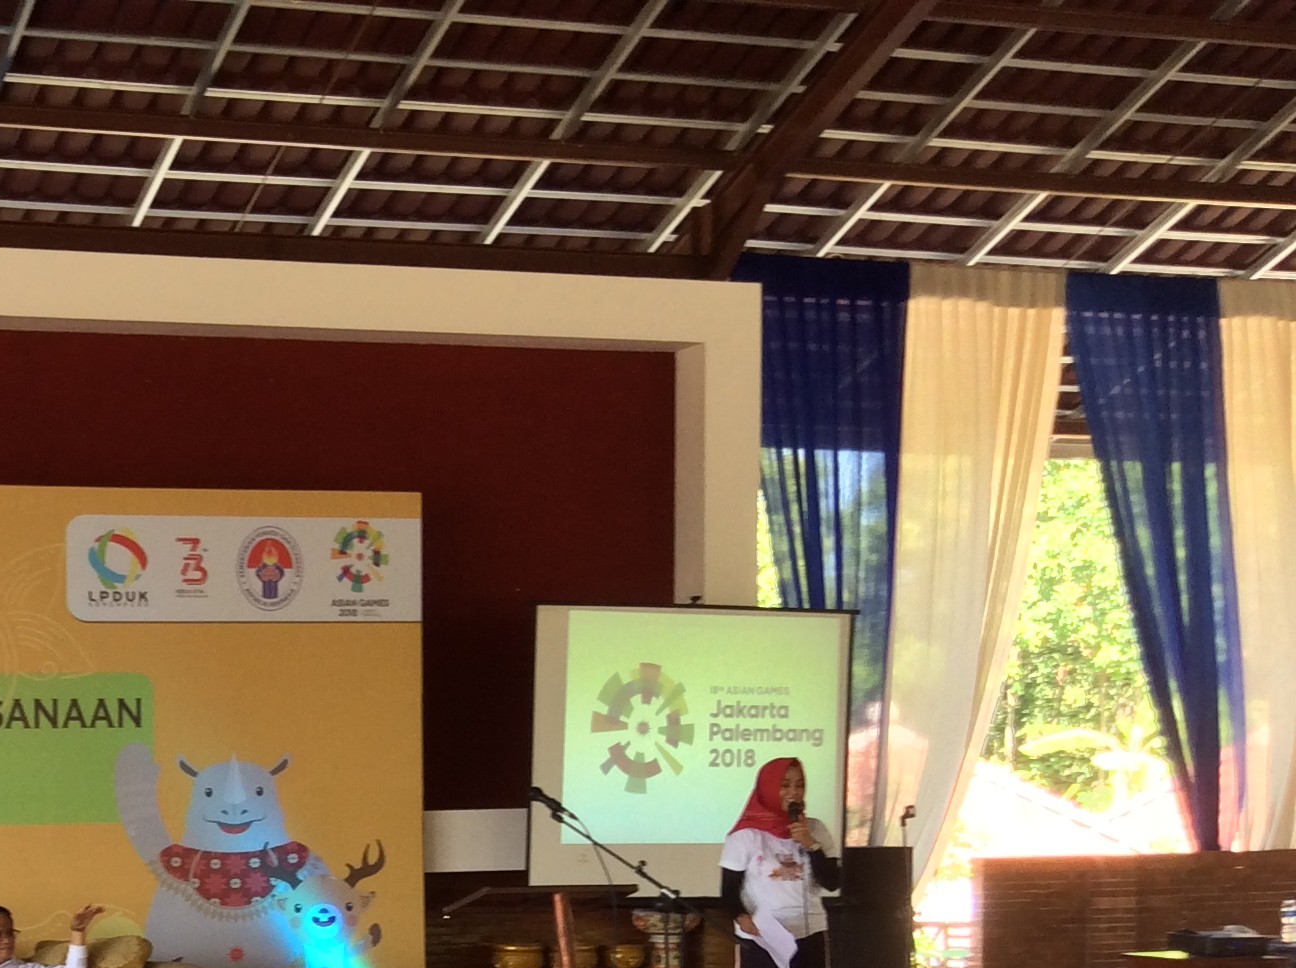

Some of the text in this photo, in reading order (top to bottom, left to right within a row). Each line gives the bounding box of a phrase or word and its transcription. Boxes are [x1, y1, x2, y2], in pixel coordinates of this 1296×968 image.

[88, 590, 149, 602] LPDUK
[709, 699, 790, 718] Jakarta
[709, 722, 824, 748] Palembang
[708, 748, 757, 768] 2018
